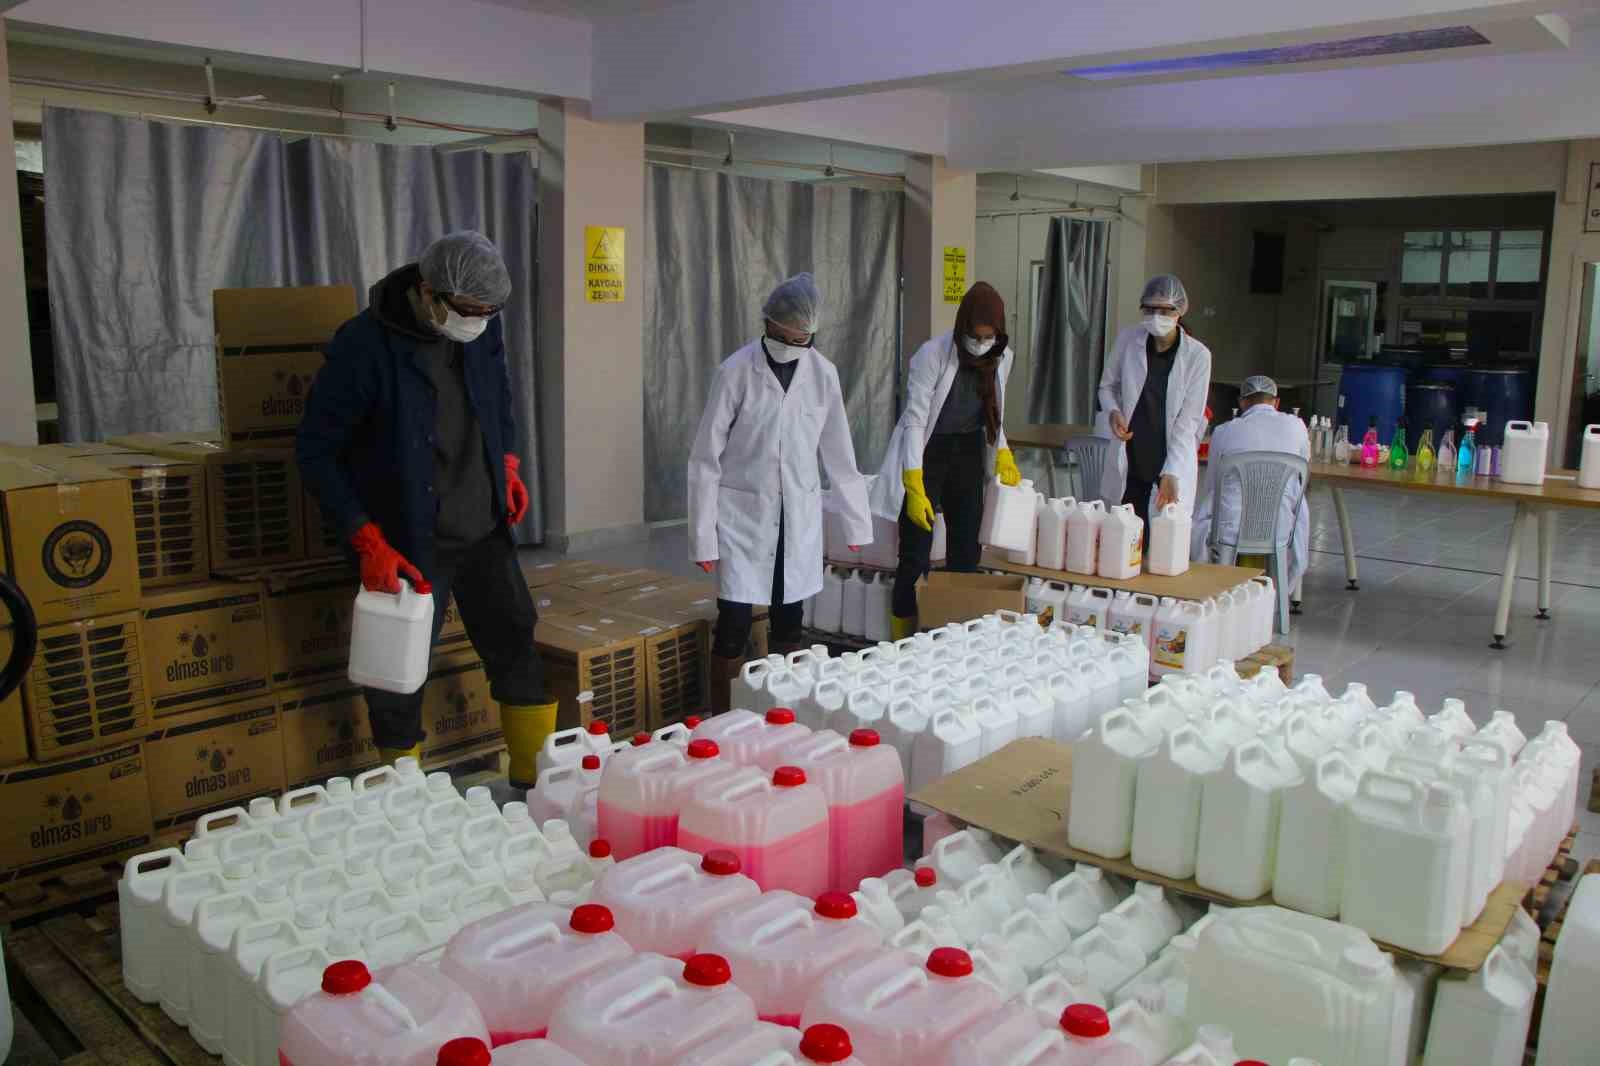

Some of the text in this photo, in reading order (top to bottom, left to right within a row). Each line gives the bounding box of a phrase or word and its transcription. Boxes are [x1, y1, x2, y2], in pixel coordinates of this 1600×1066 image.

[166, 658, 208, 682] elmas
[185, 773, 226, 798] elmas
[31, 822, 81, 848] elmas
